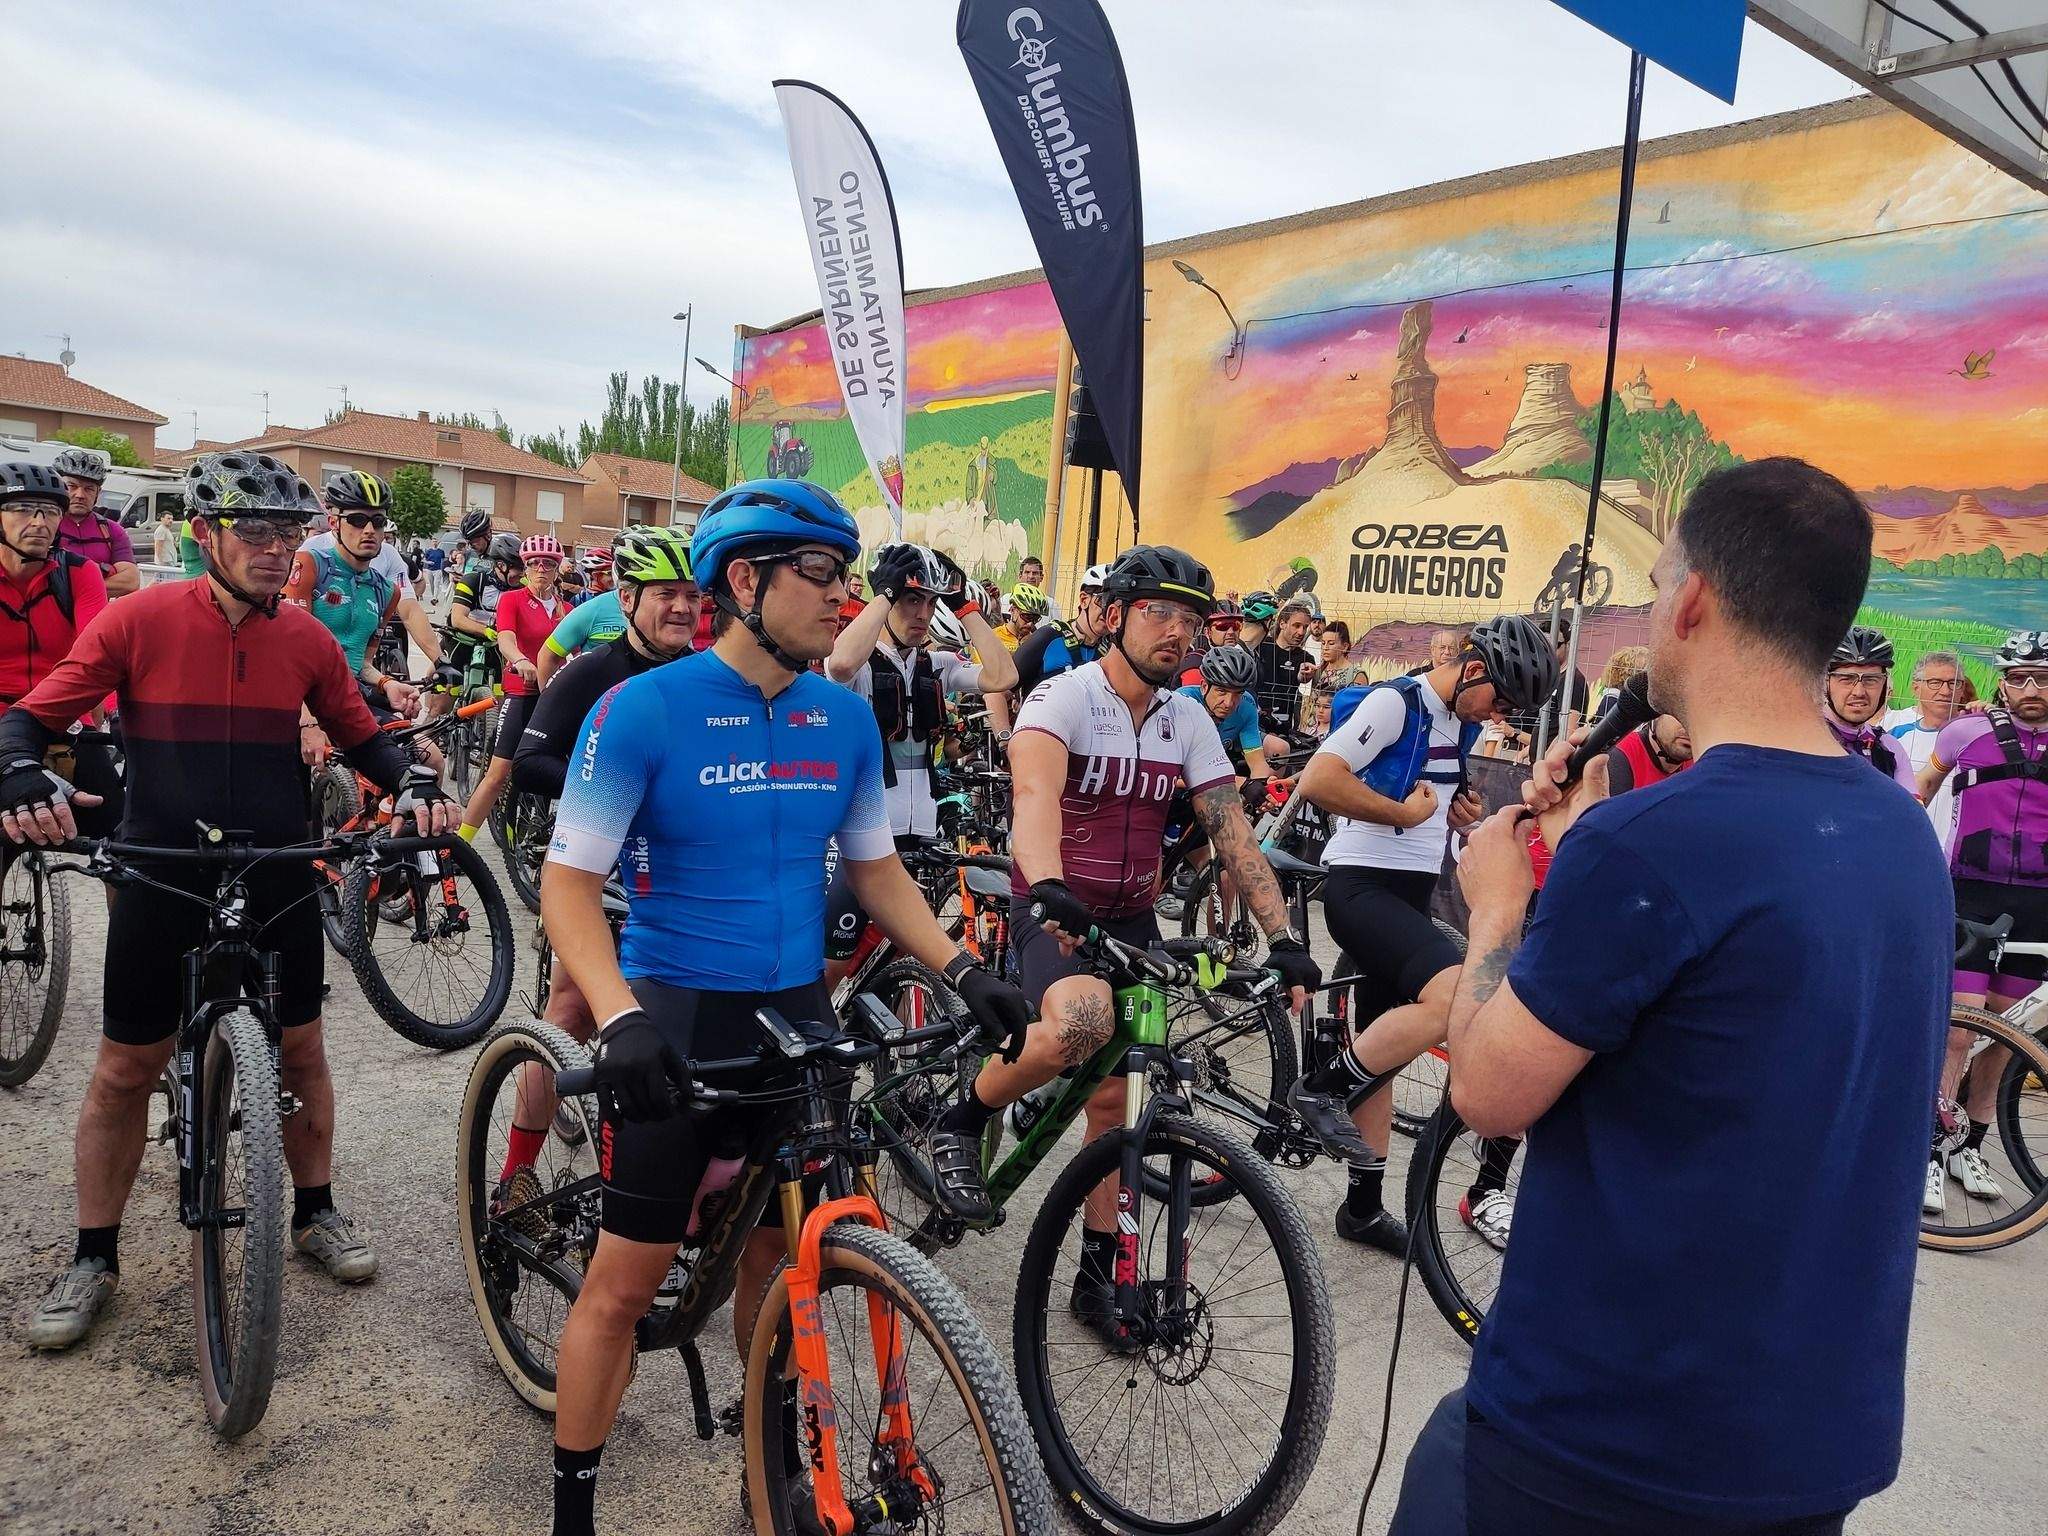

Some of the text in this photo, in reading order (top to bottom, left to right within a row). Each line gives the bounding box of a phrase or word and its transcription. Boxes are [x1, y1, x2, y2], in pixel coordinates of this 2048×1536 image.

[1006, 6, 1103, 228] Columbus
[1016, 94, 1076, 232] DISCOVER NATURE
[1351, 523, 1509, 553] ORBEA
[1347, 554, 1506, 599] MONEGROS
[706, 716, 750, 727] FASTER
[1273, 793, 1300, 841] ORBE
[832, 929, 856, 939] Planet
[600, 1119, 615, 1182] AUTOS
[804, 1403, 825, 1473] FOX
